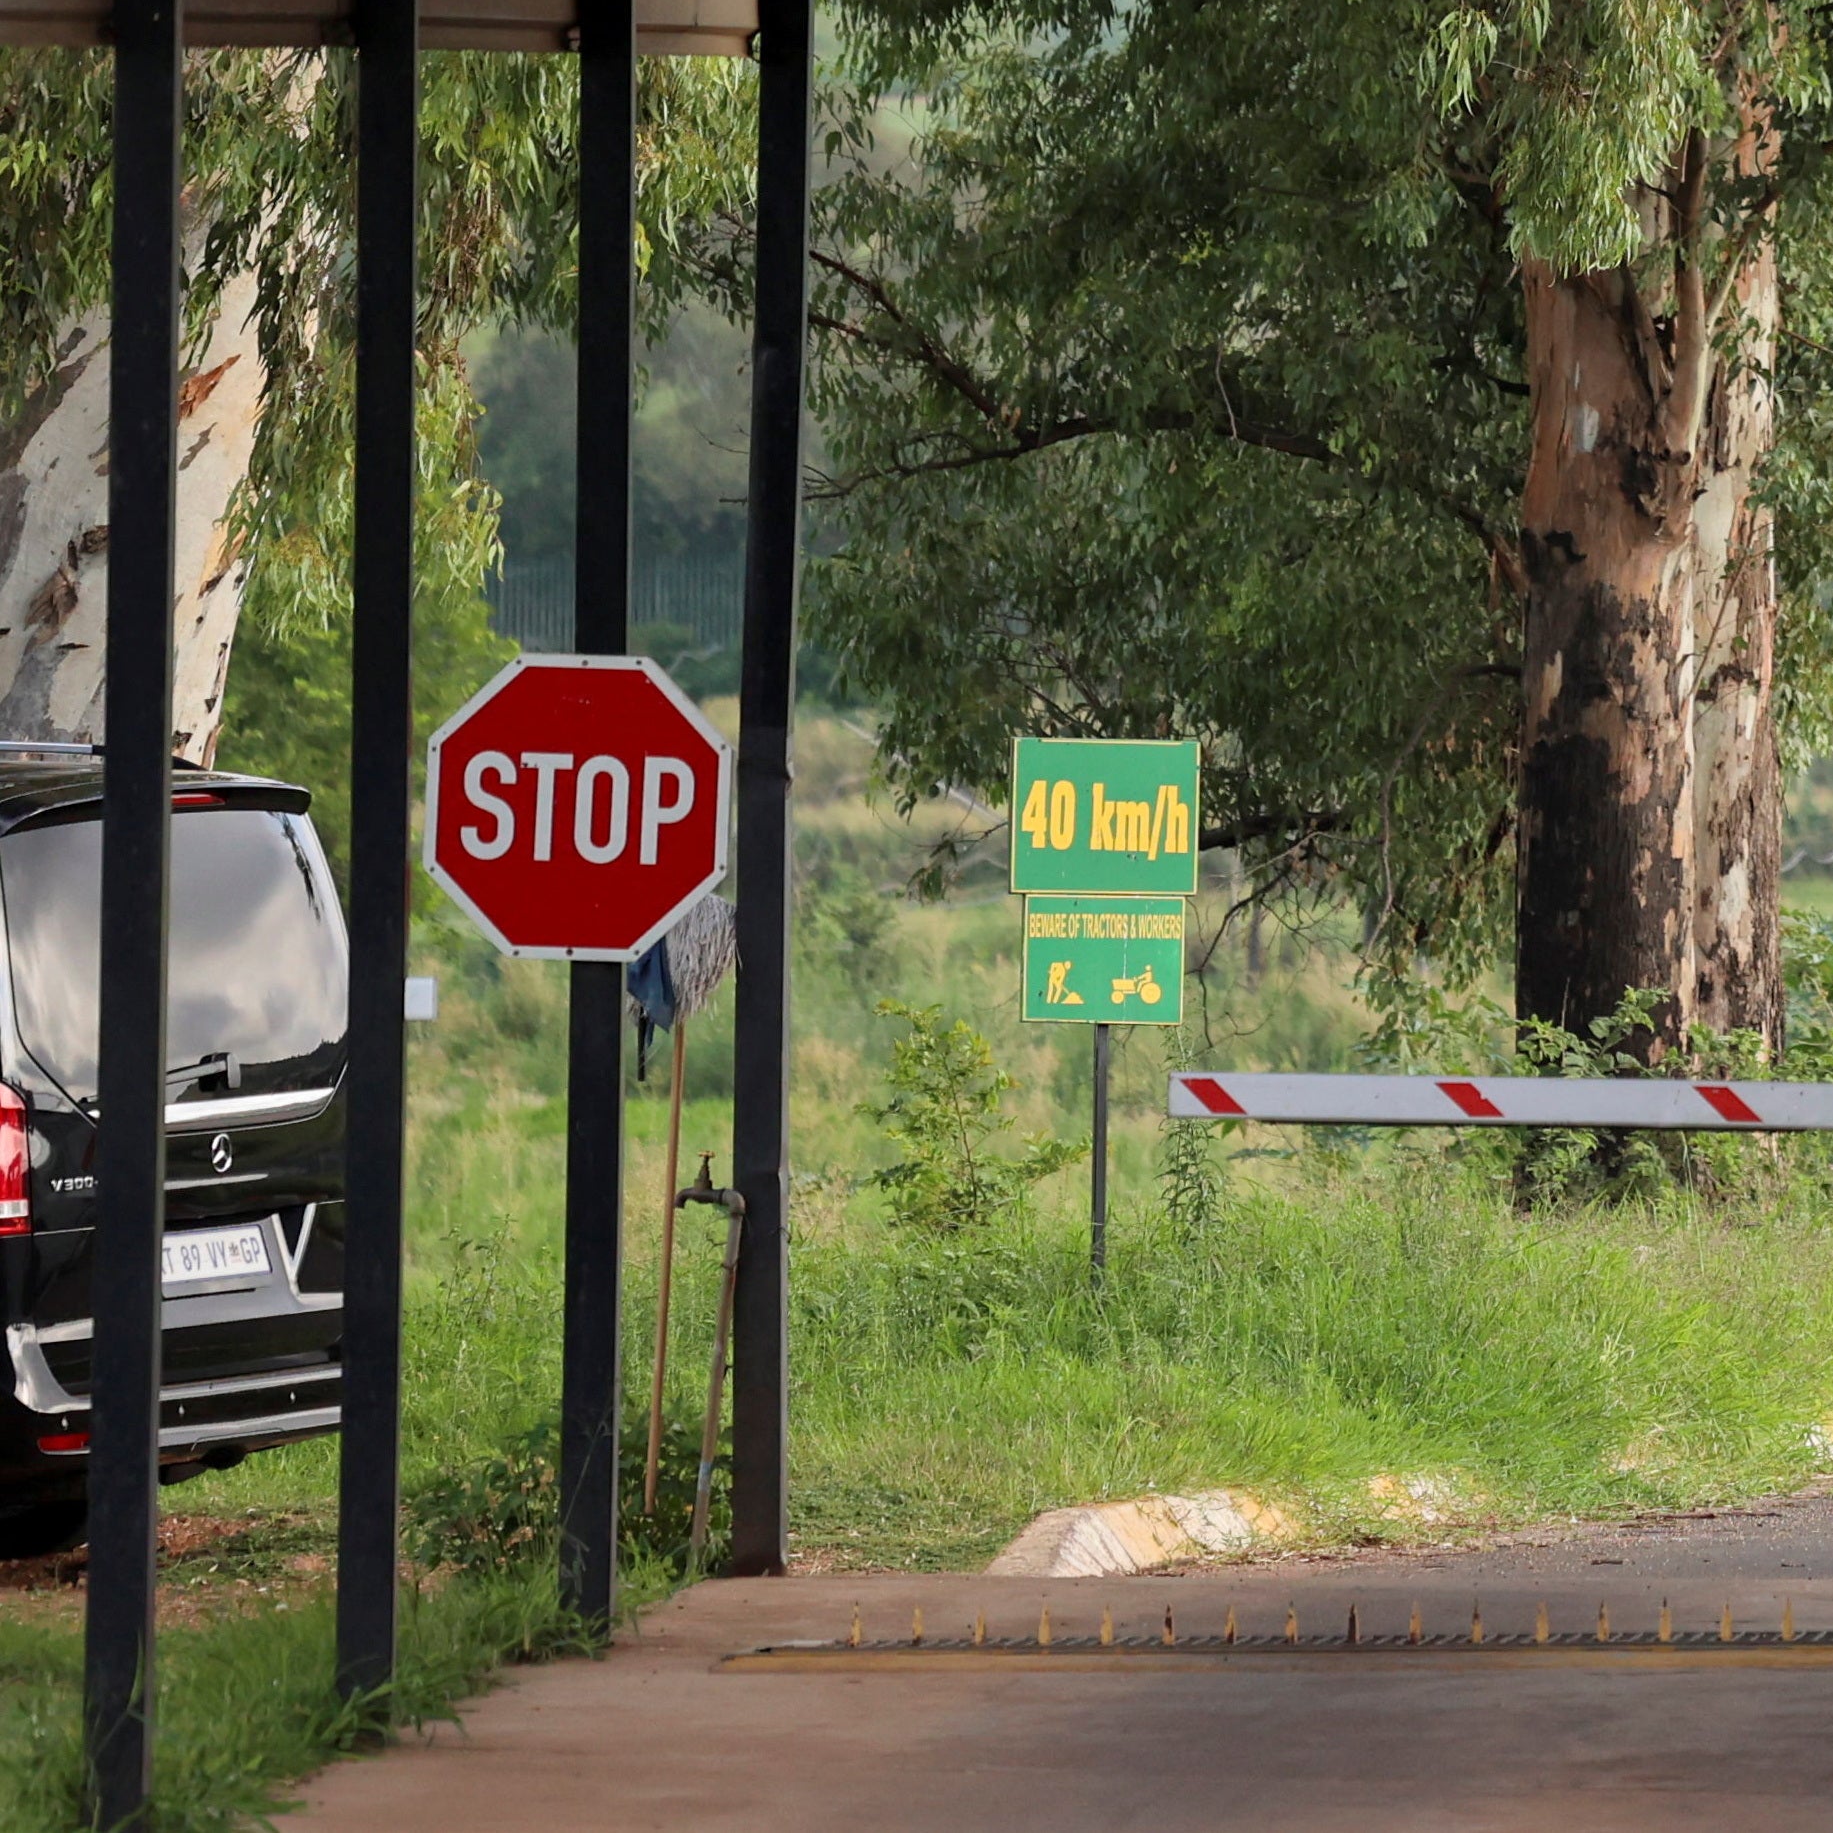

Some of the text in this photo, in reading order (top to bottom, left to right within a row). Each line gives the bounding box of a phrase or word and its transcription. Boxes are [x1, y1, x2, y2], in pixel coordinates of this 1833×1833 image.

[460, 749, 696, 866] STOP
[1021, 779, 1190, 861] 40 km/h
[1029, 913, 1182, 940] BEWARE OF TRACTORS & WORKERS
[161, 1236, 260, 1275] T 89 VY GP
